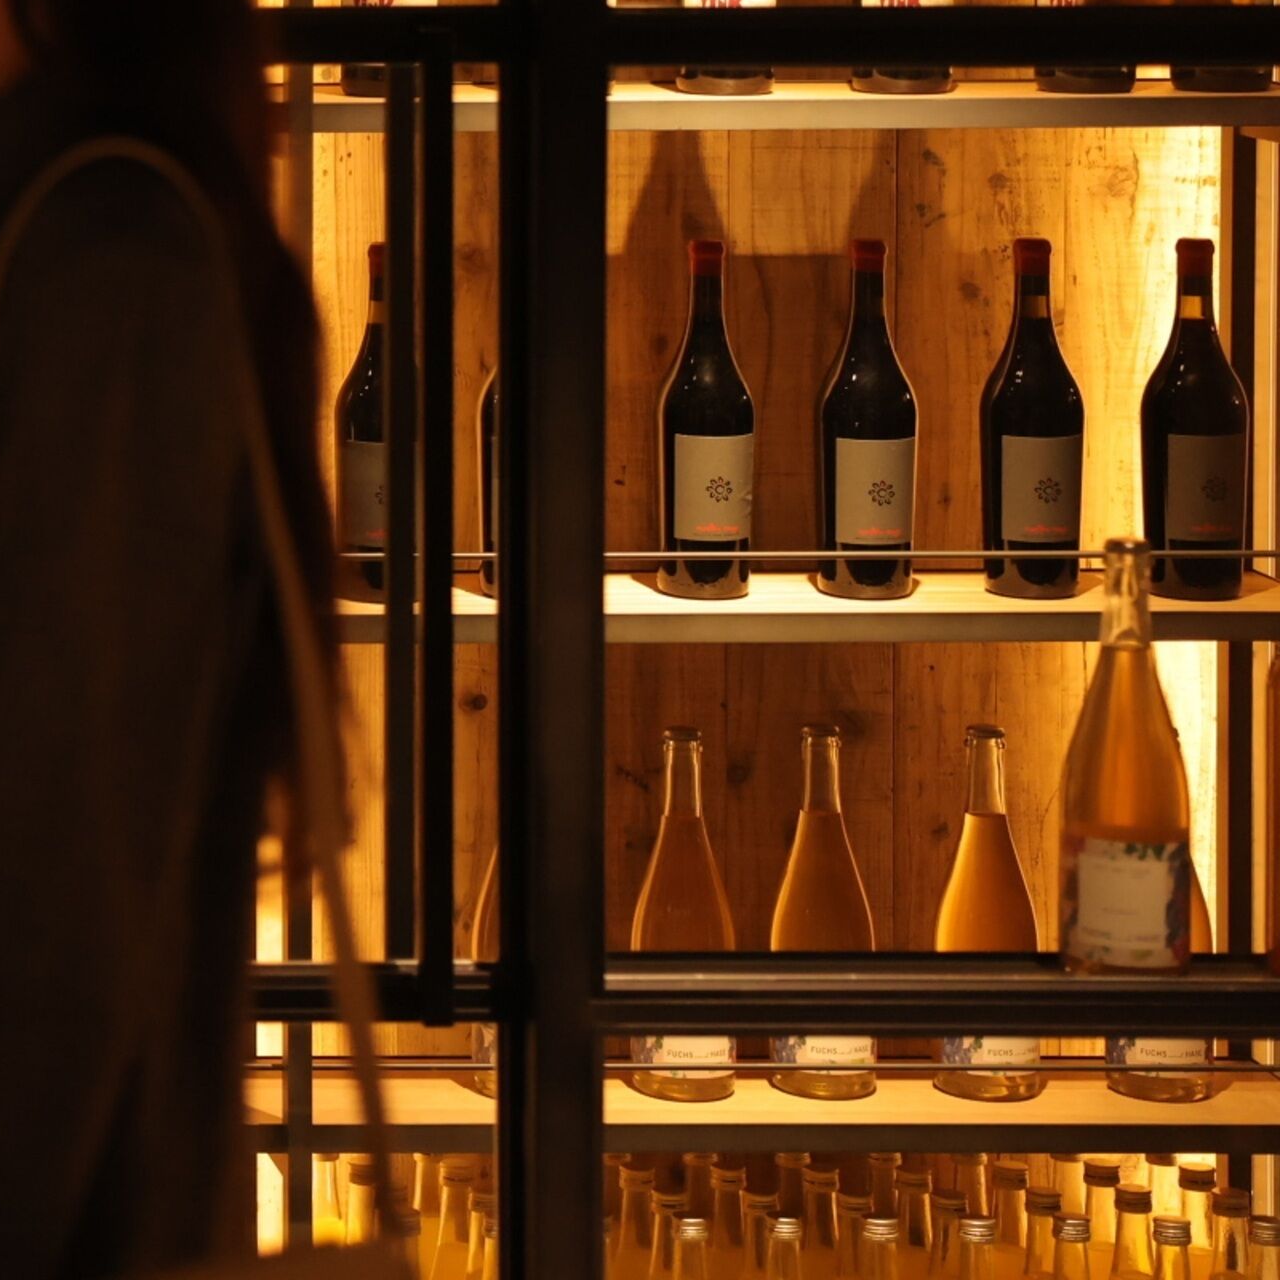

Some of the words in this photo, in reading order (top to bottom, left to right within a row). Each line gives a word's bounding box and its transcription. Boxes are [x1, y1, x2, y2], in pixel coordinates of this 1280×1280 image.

[667, 1048, 694, 1059] FUCHS
[810, 1045, 838, 1057] FUCHS
[987, 1047, 1014, 1058] FUCHS
[1140, 1047, 1168, 1059] FUCHS
